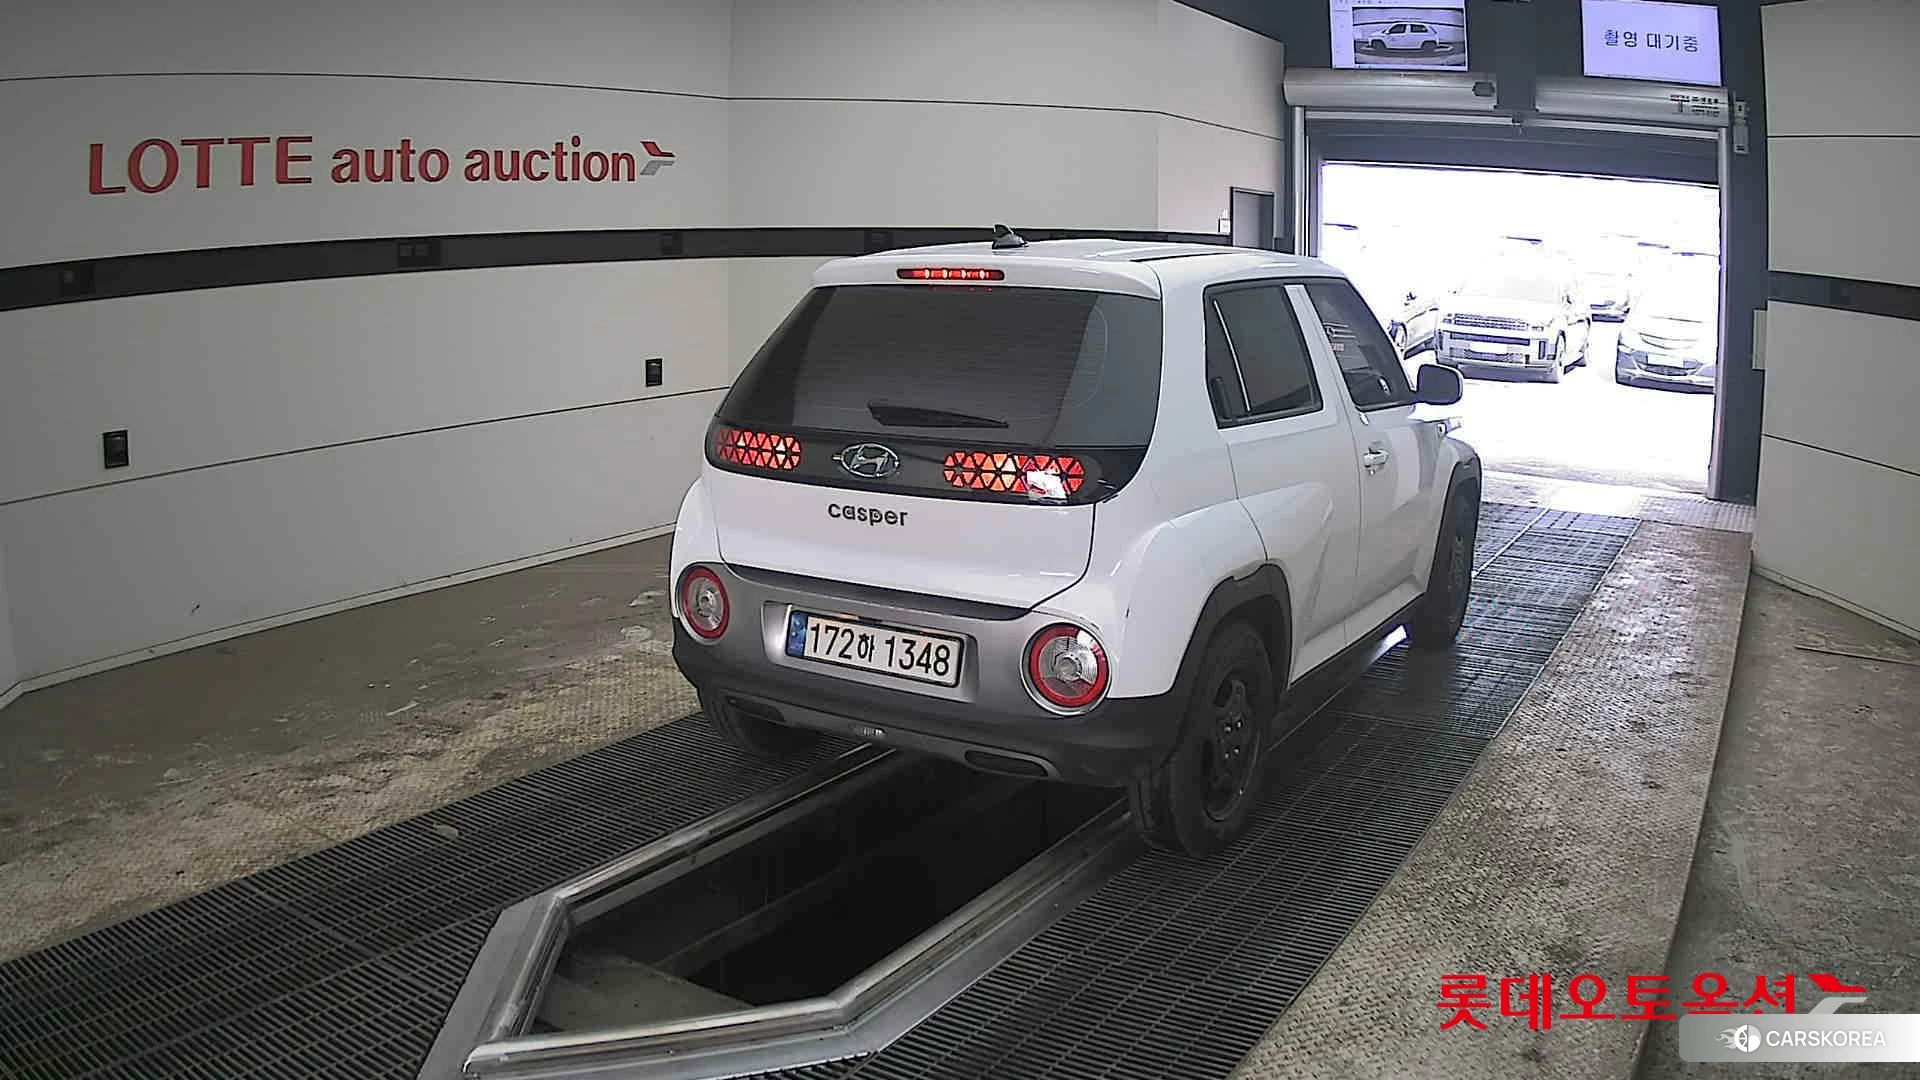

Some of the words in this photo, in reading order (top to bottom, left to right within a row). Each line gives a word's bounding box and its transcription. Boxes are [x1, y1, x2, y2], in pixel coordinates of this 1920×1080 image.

[1646, 33, 1698, 52] 대기중
[89, 136, 312, 194] LOTTE
[331, 139, 449, 183] auto
[464, 135, 636, 182] auction
[828, 503, 908, 526] casper
[810, 623, 875, 662] 172하
[885, 635, 950, 676] 1348
